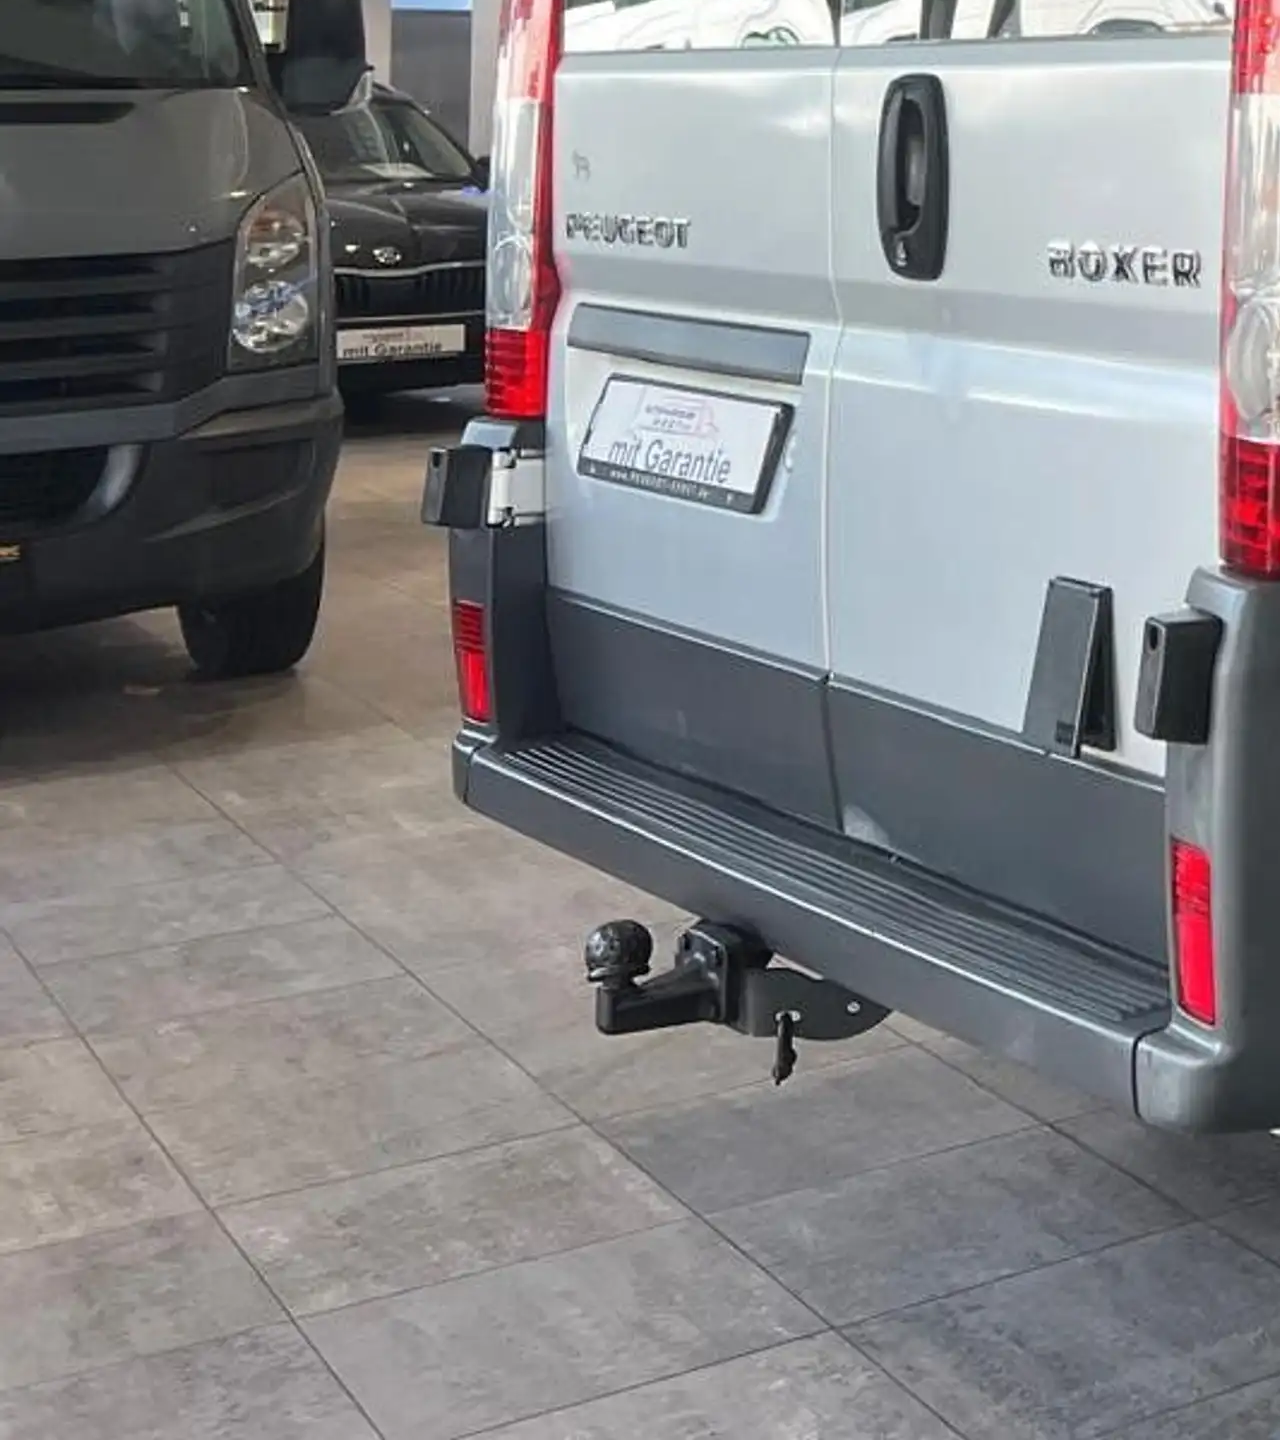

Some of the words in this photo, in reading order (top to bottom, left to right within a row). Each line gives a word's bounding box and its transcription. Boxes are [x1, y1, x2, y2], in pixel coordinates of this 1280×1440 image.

[566, 213, 691, 249] PEUGEOT
[1047, 240, 1202, 288] BOXER
[609, 435, 643, 469] mit
[645, 439, 731, 483] Garantie
